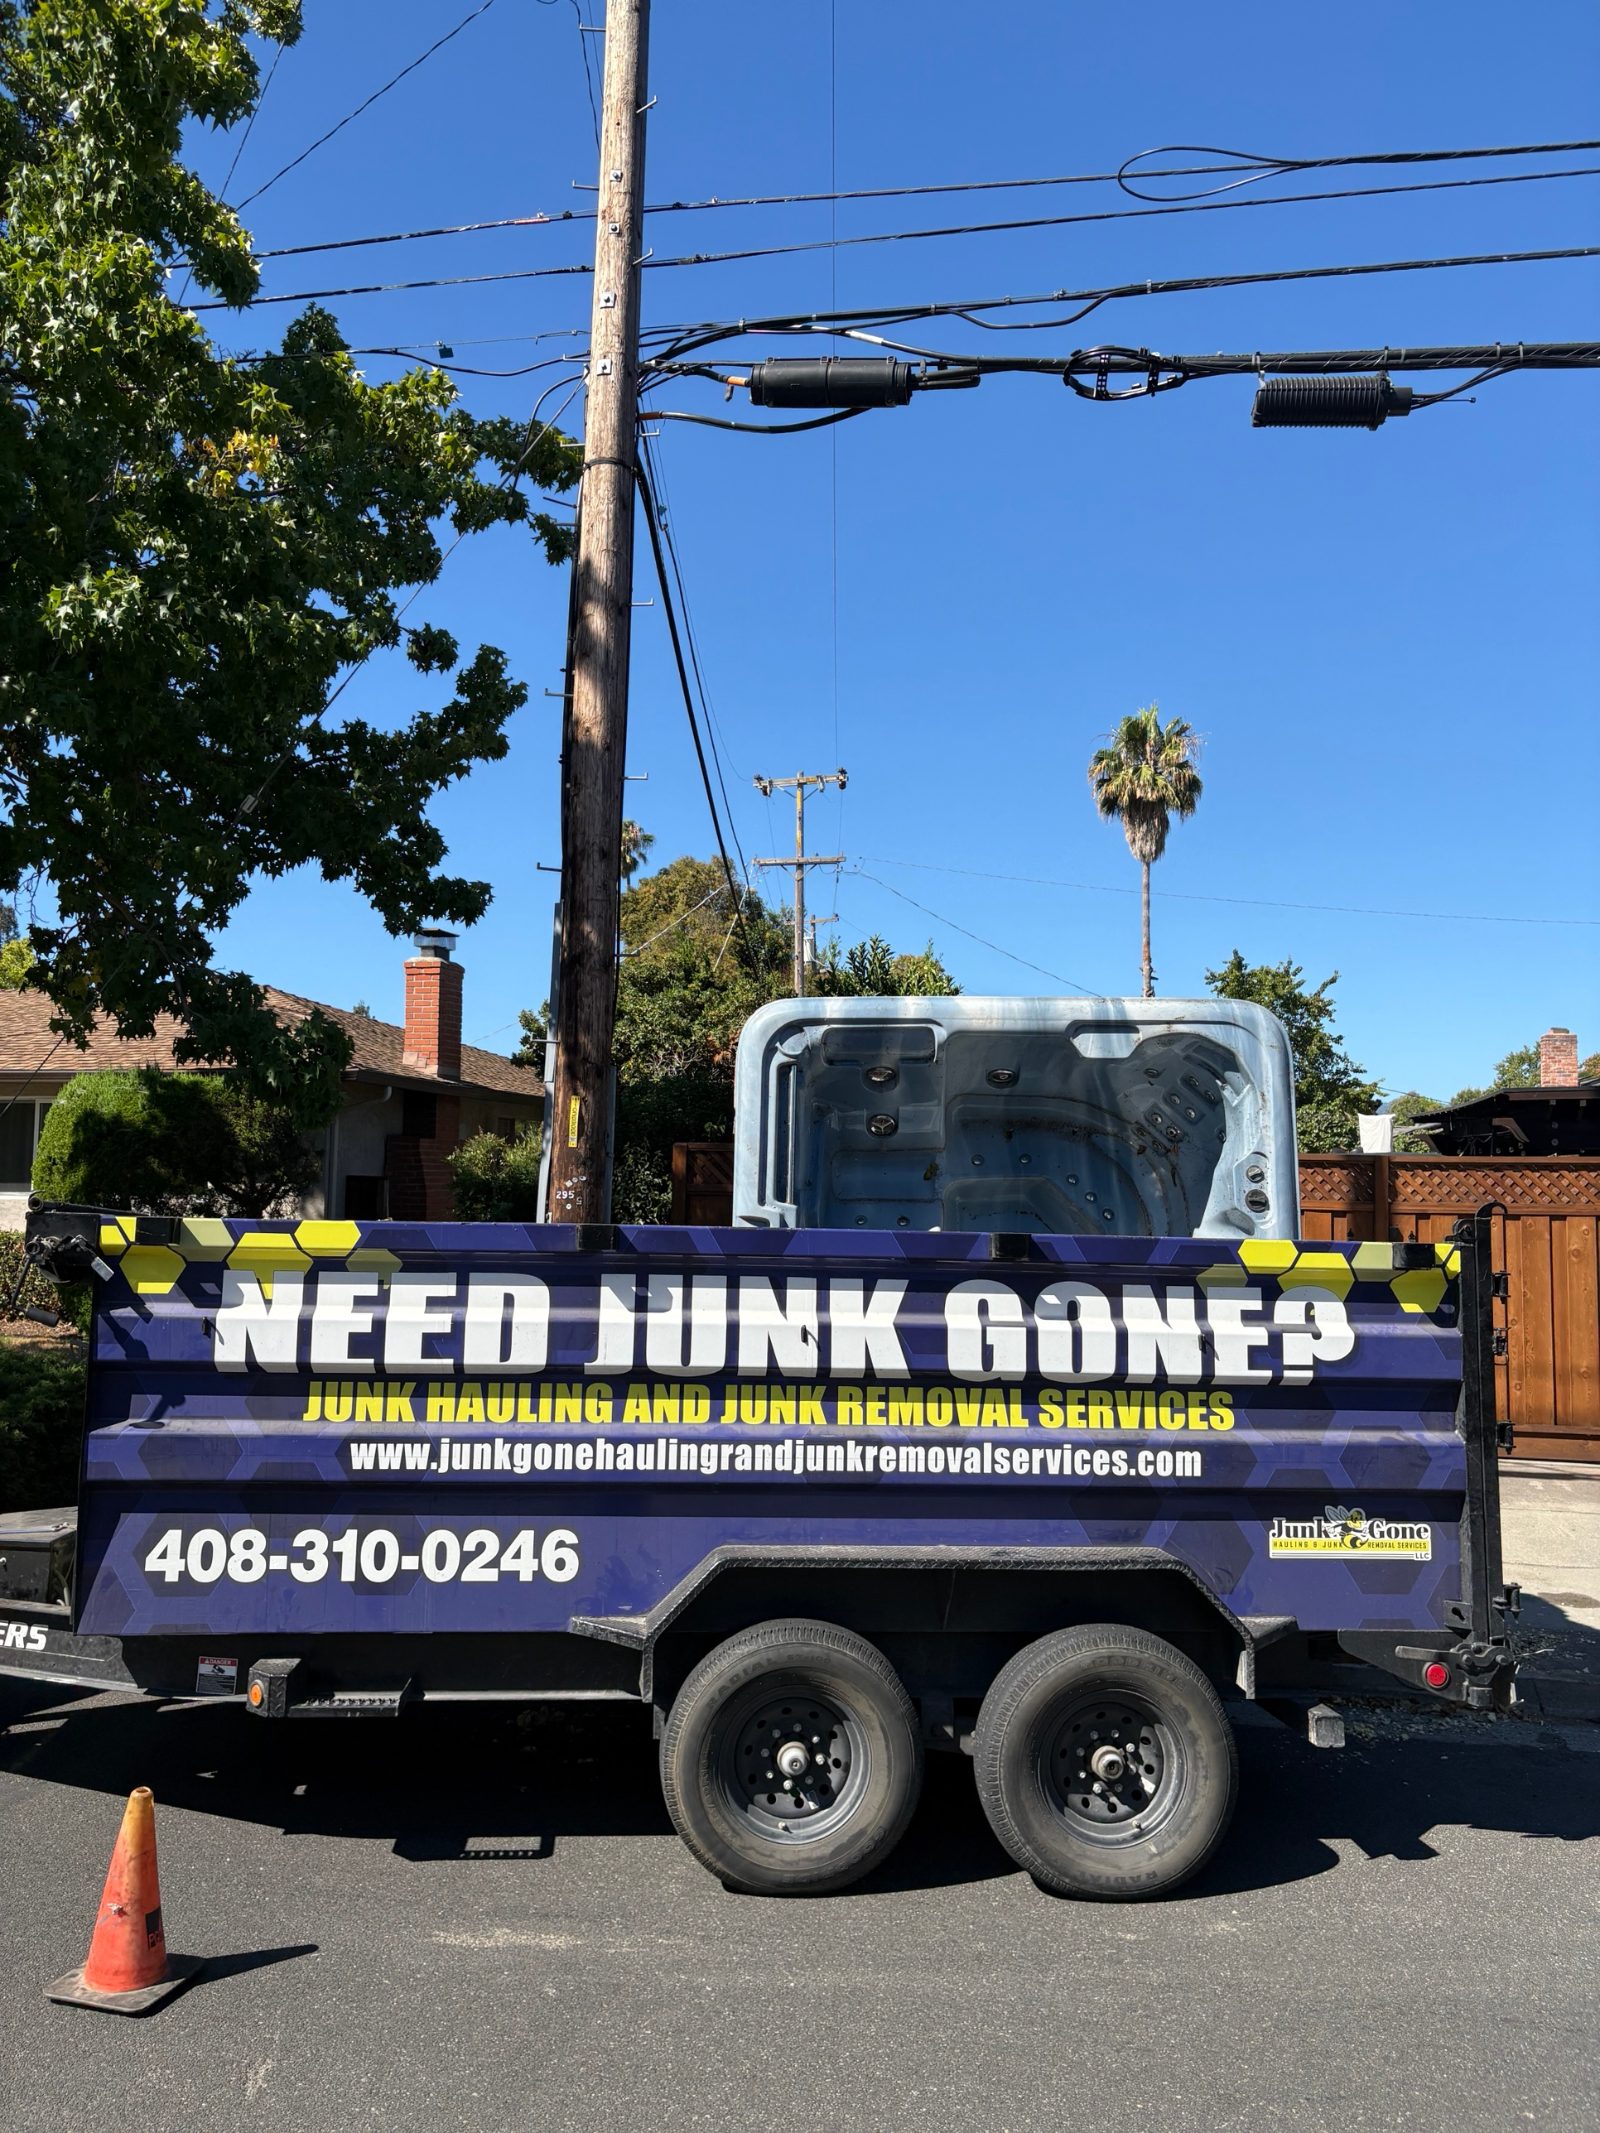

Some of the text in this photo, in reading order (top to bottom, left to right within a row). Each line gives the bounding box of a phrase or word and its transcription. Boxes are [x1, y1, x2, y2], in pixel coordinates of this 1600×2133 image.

[556, 1190, 575, 1199] 295
[213, 1269, 1357, 1386] NEED JUNK GONE?
[303, 1381, 1236, 1432] JUNK HAULING AND JUNK REMOVAL SERVICES
[351, 1437, 1203, 1477] www.junkgonehaulingrandjunkremovalservices.com
[1271, 1518, 1429, 1540] Junk Gone
[144, 1529, 580, 1584] 408-310-0246
[1273, 1541, 1309, 1549] HAULING
[1367, 1541, 1395, 1549] REMOVAL
[1397, 1541, 1427, 1549] SERVICES
[1415, 1552, 1430, 1560] LLC
